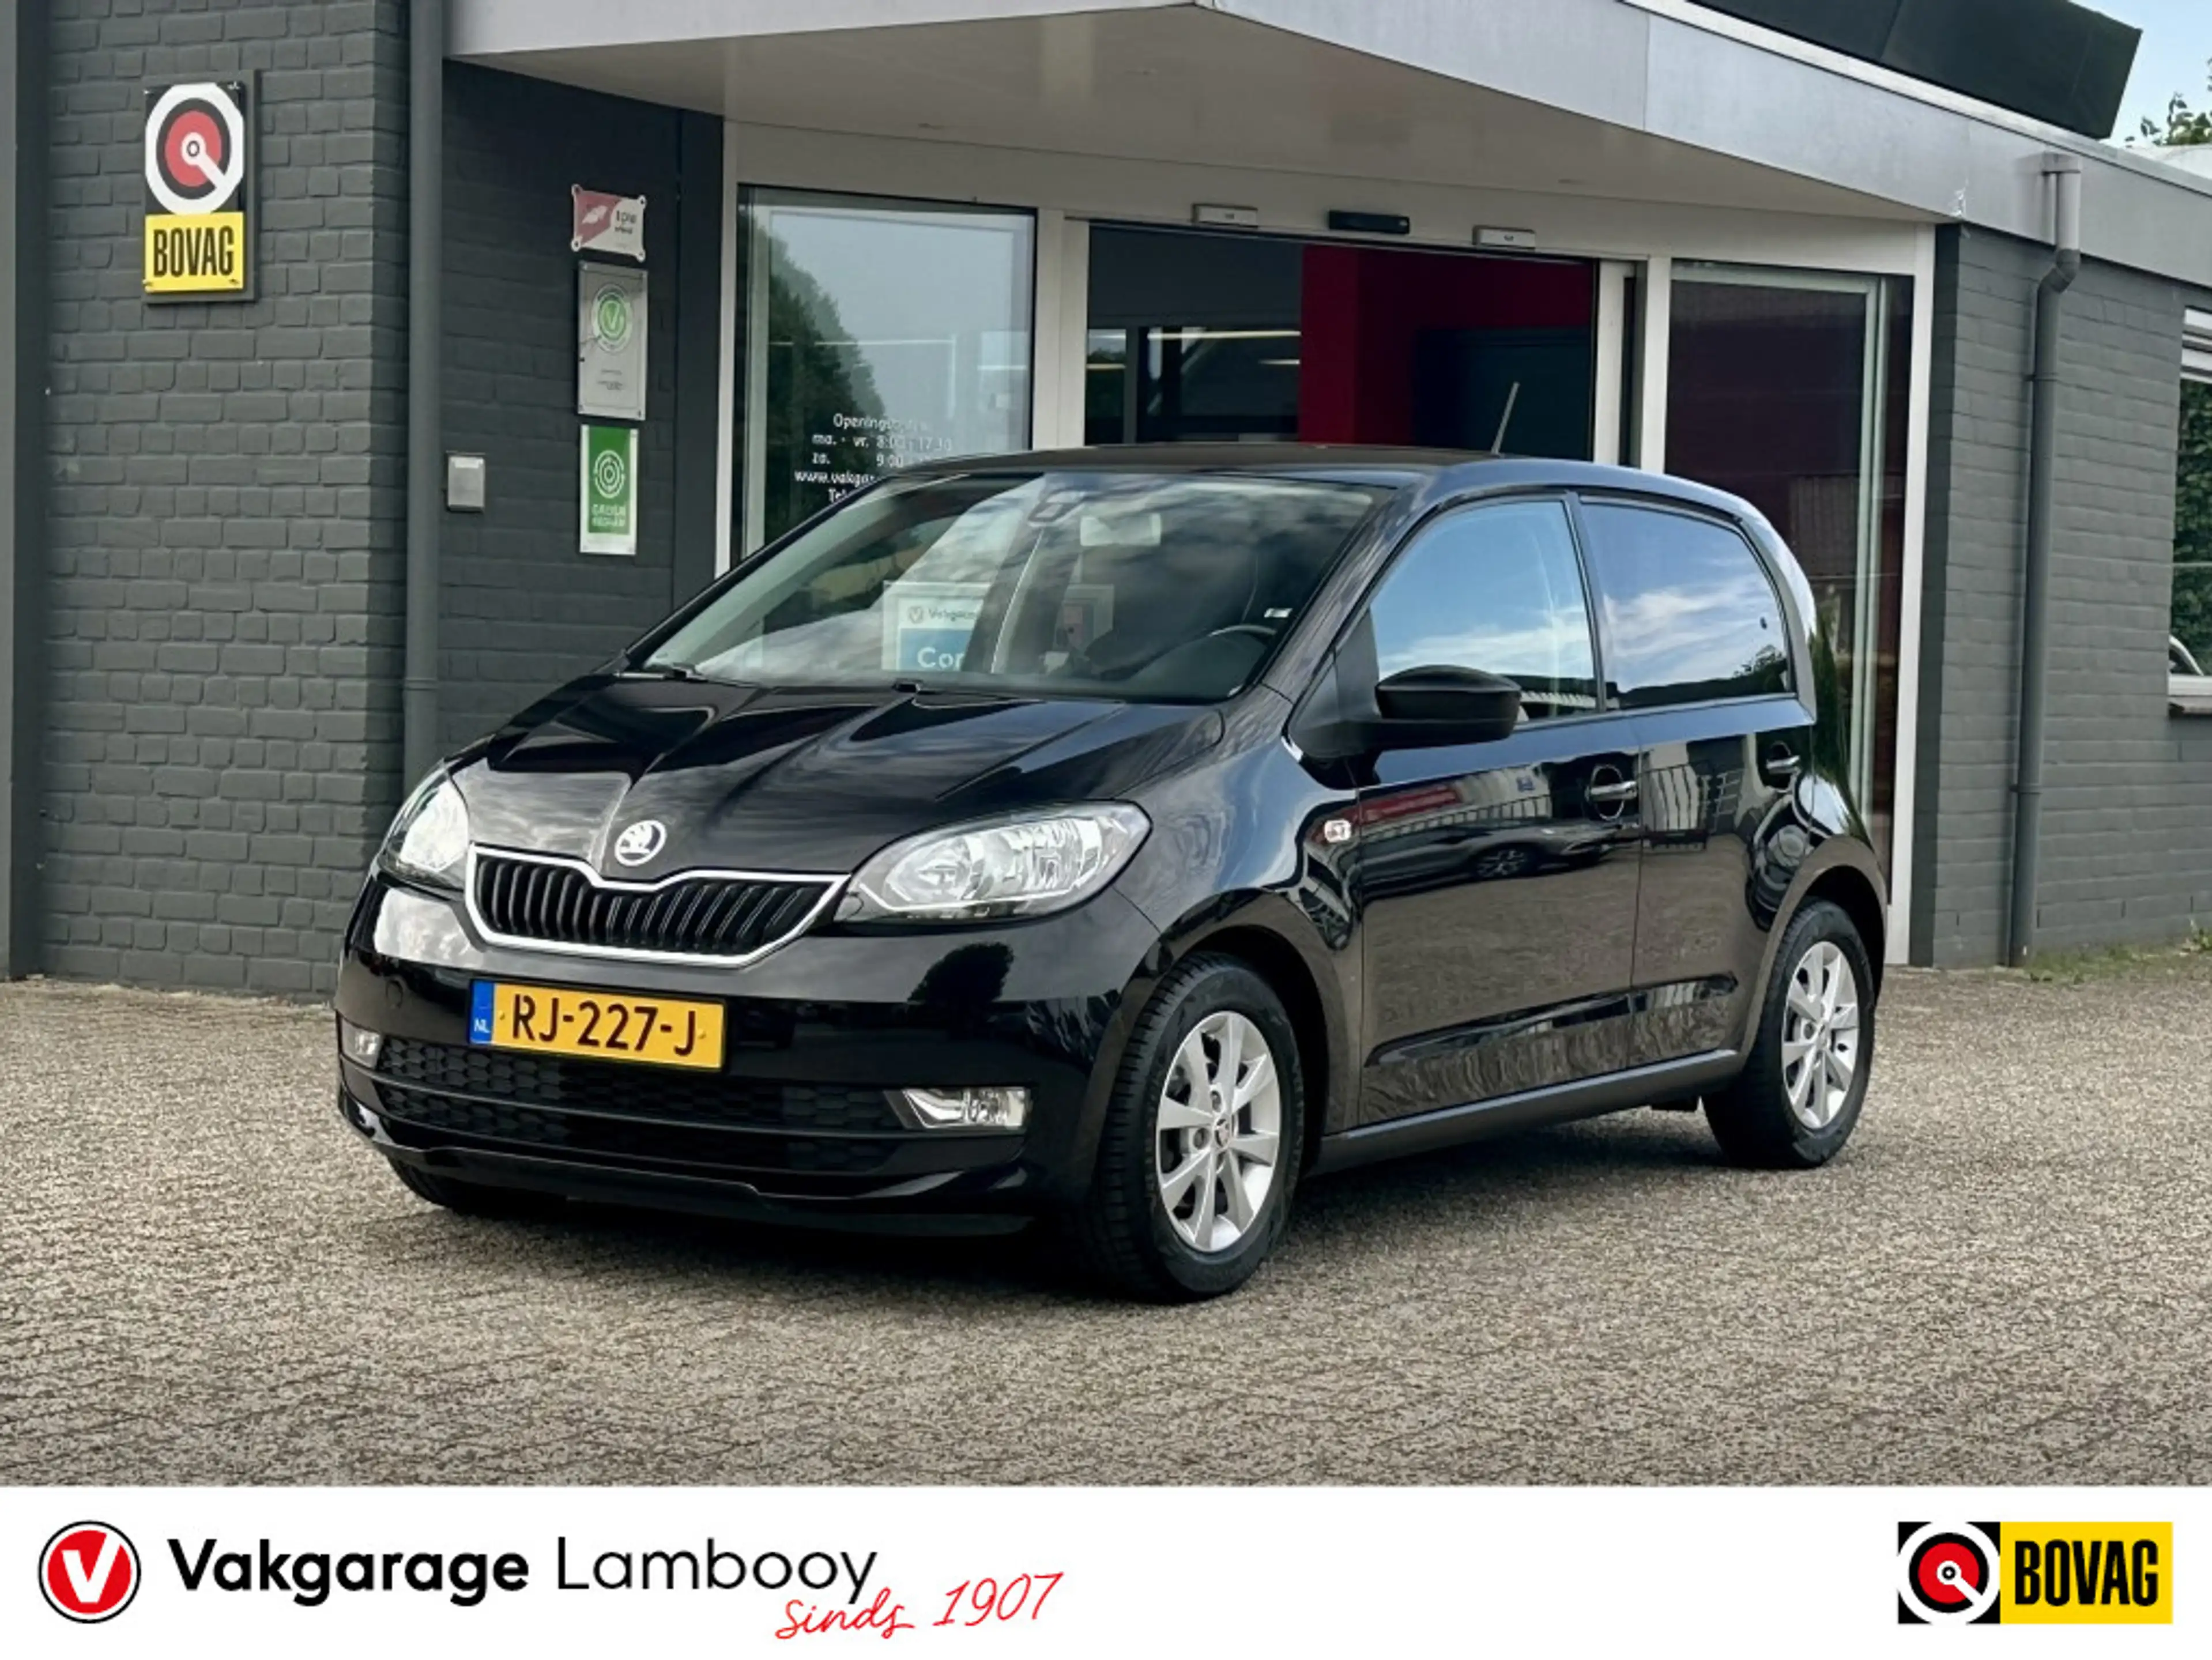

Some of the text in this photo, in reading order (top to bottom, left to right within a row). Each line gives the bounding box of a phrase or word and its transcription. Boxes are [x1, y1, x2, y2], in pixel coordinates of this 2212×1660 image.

[153, 226, 234, 277] BOVAG
[812, 434, 837, 446] ma.
[474, 1020, 491, 1033] NL
[513, 993, 696, 1056] RJ-227-J
